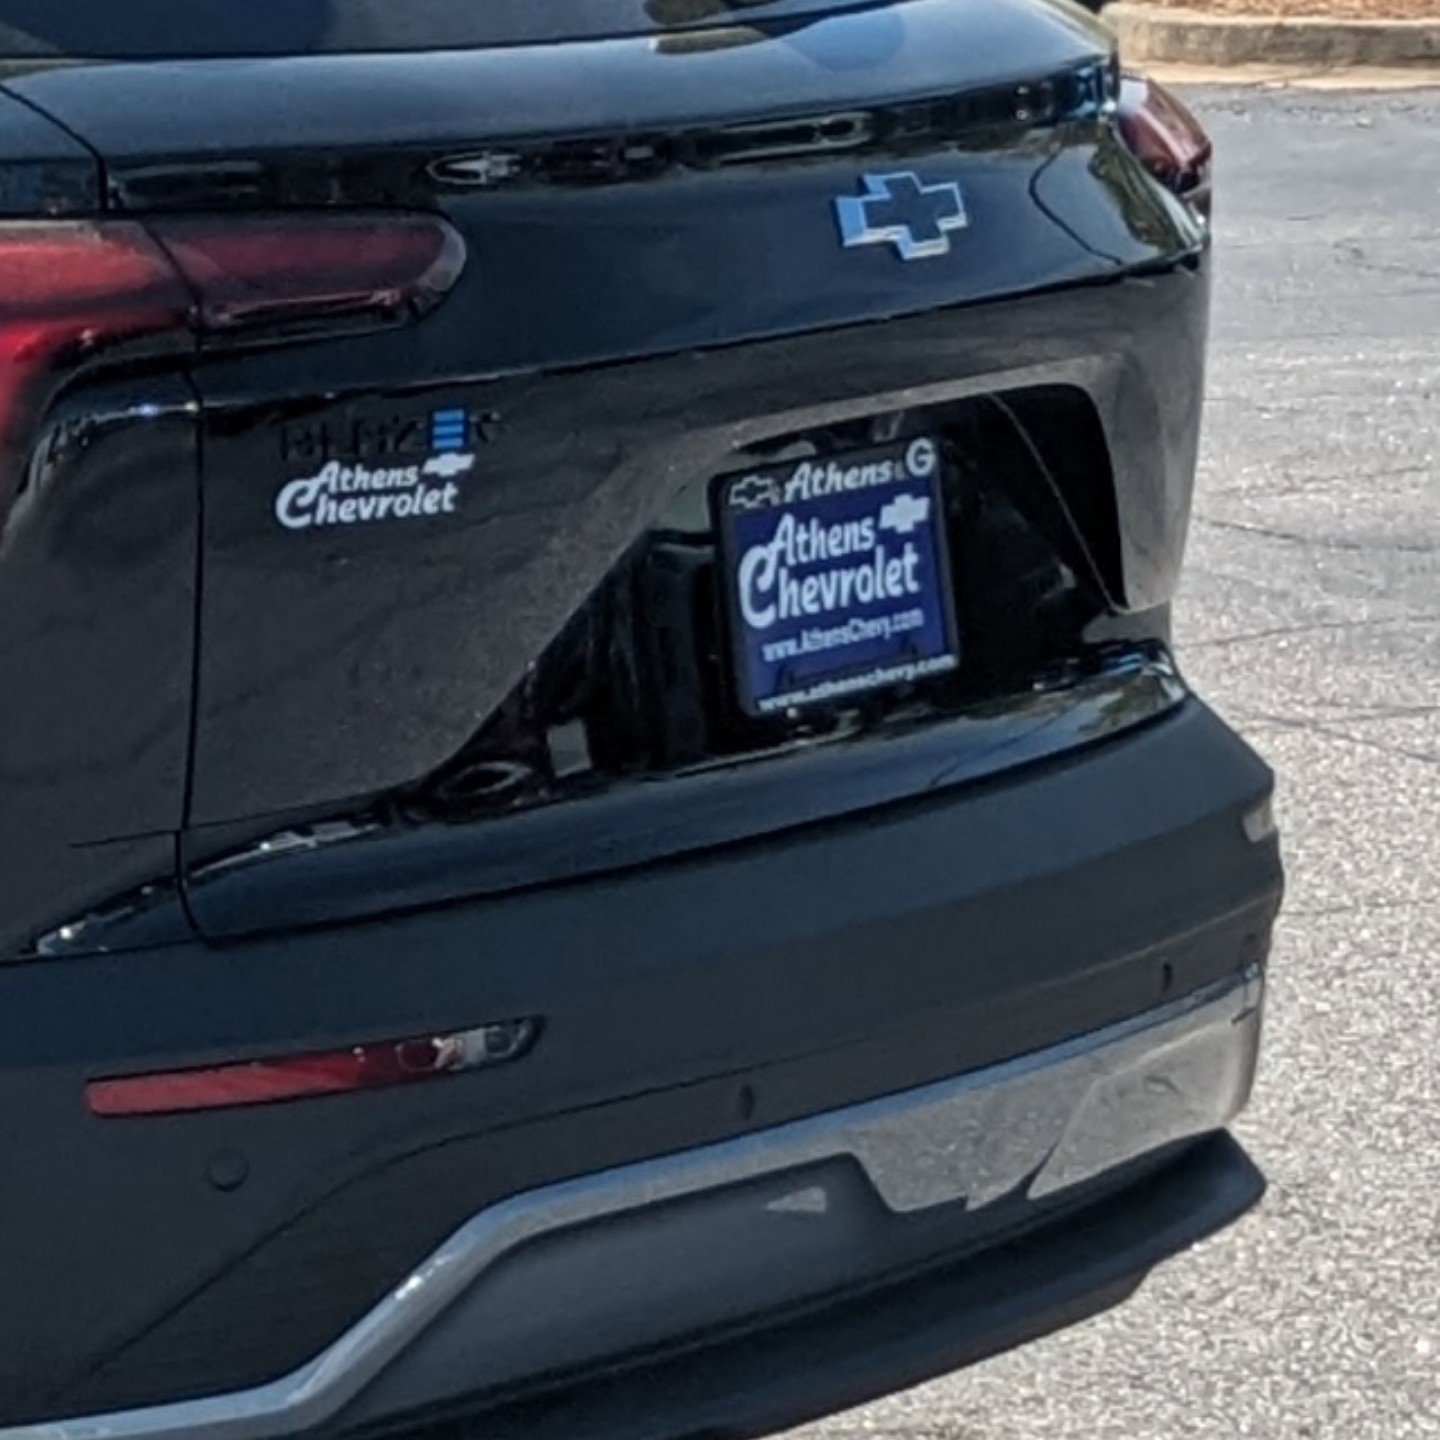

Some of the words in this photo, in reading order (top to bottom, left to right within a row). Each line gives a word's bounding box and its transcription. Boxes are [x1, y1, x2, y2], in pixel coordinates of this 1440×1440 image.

[314, 459, 420, 494] Athens
[783, 458, 893, 504] Athens
[275, 477, 459, 529] Chevrolet
[768, 512, 877, 566] Athens
[738, 541, 920, 629] Chevrolet
